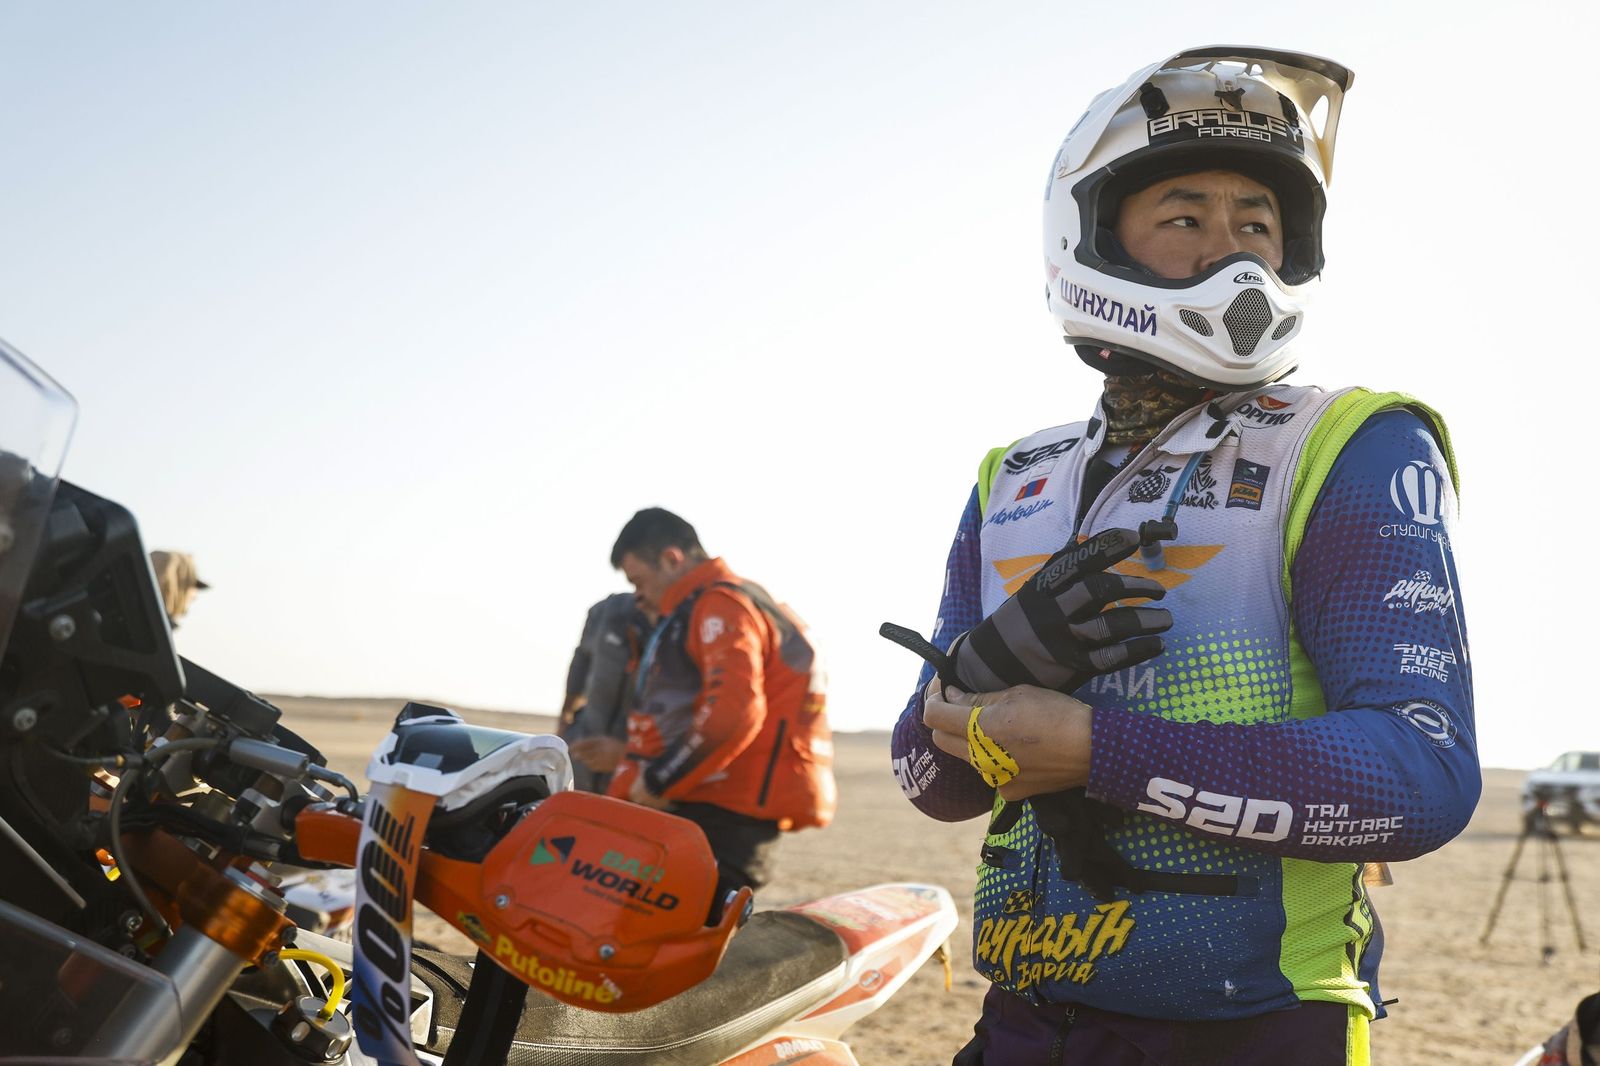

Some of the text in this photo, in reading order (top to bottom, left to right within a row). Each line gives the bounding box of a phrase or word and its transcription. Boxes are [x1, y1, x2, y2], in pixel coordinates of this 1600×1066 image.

[1150, 109, 1303, 143] BRADLEY
[1198, 127, 1271, 143] FORGED
[1060, 277, 1157, 336] ШУНХЛАЙ
[1036, 530, 1122, 592] FASTHOUSE
[1393, 643, 1454, 664] HYPE
[1401, 654, 1449, 673] FUEL
[1400, 665, 1448, 683] RACING
[1137, 777, 1293, 842] S2D
[1303, 816, 1403, 833] НУТГААС
[570, 859, 680, 911] WORLD
[495, 934, 614, 1004] Putoline
